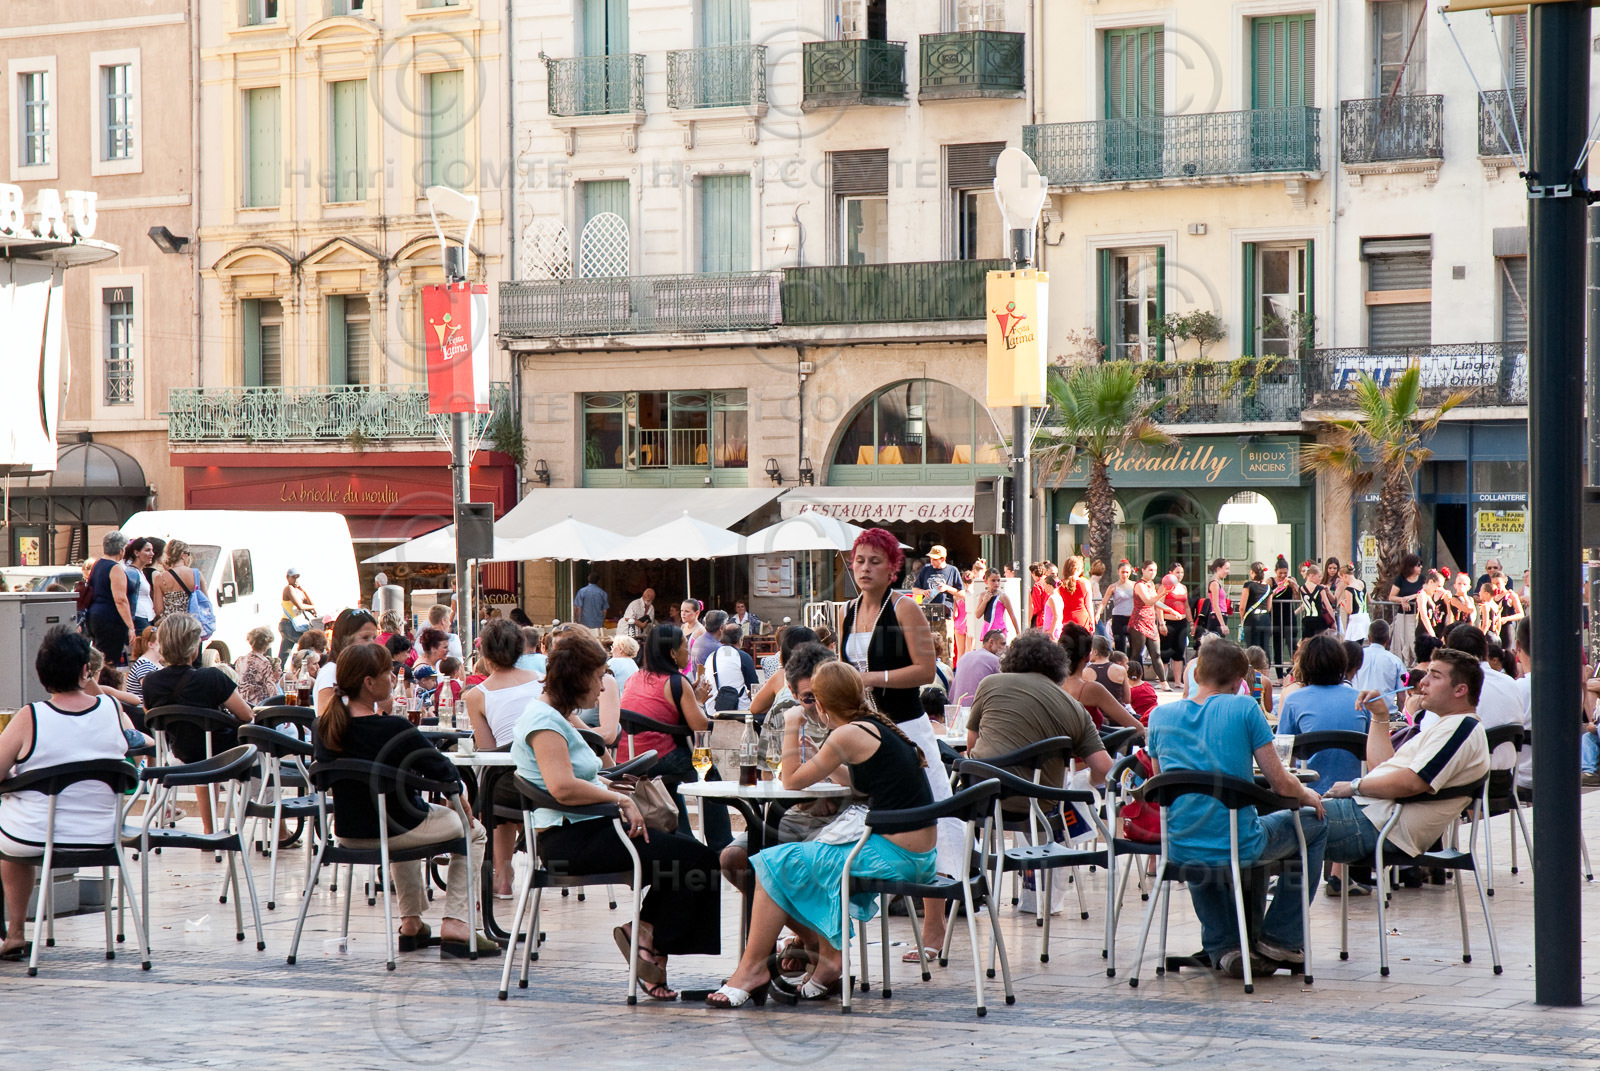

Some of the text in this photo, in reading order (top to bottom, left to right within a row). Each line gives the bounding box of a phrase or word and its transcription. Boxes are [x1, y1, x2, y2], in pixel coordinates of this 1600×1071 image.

[1005, 333, 1034, 351] Latina
[441, 344, 468, 360] Latina
[1103, 445, 1234, 483] Piccadilly
[1249, 452, 1286, 463] BIJOUX
[1249, 463, 1287, 472] ANCIENS
[280, 483, 399, 504] La brioche du moulin
[1365, 494, 1382, 502] LIN
[483, 593, 517, 605] AGORA
